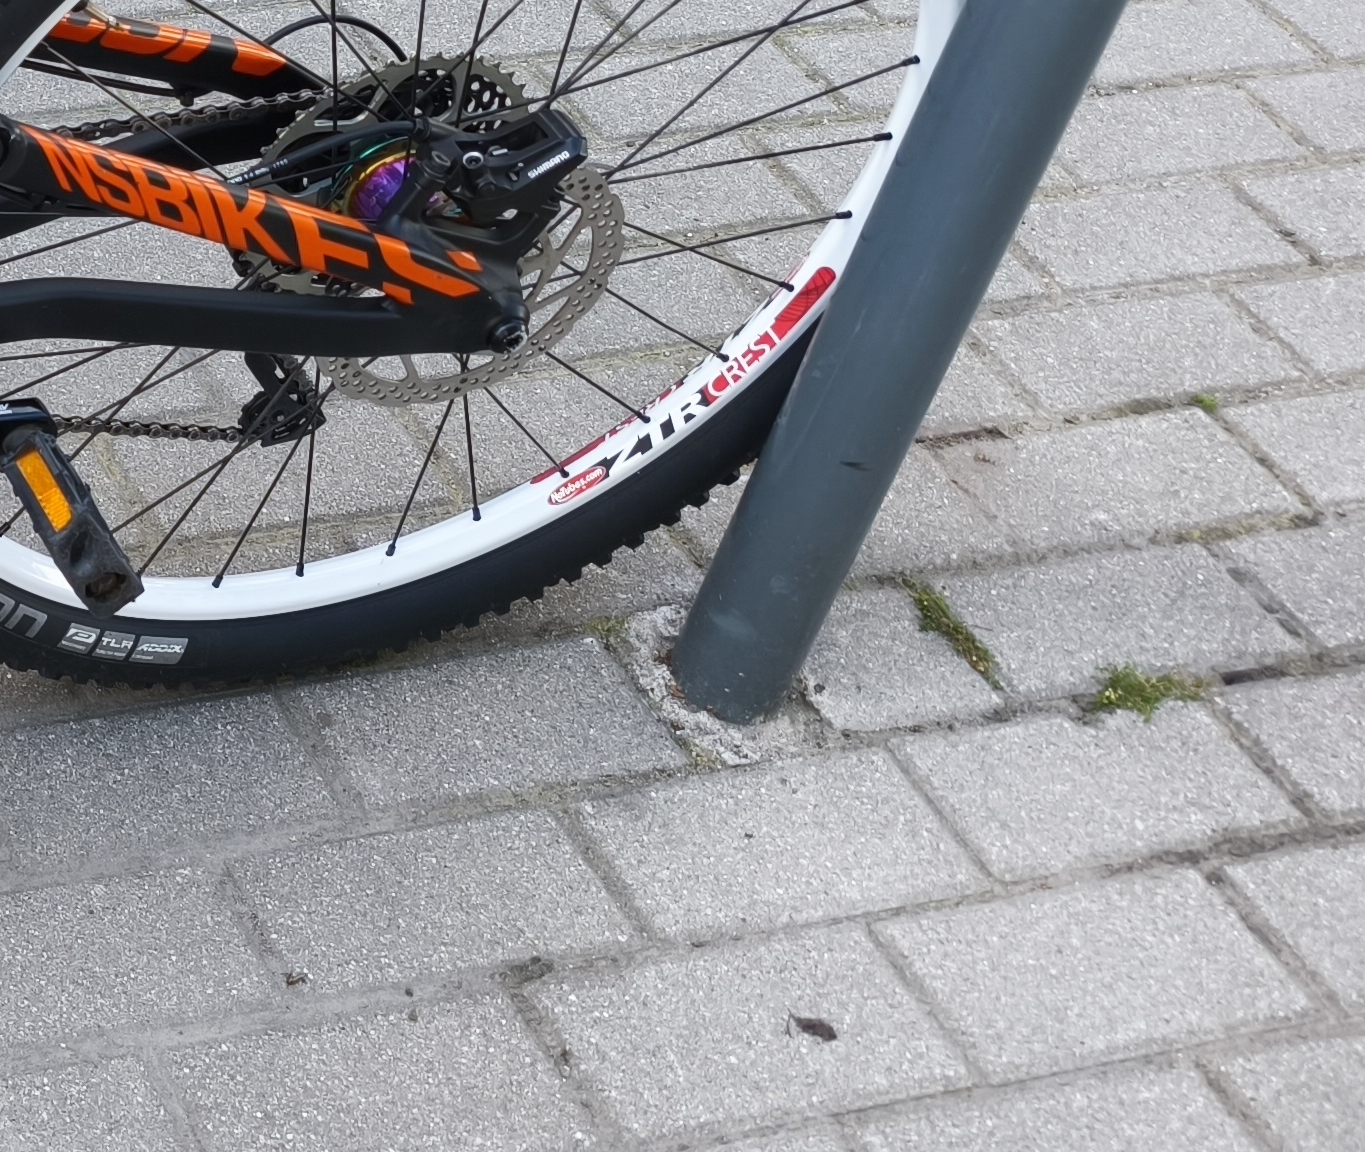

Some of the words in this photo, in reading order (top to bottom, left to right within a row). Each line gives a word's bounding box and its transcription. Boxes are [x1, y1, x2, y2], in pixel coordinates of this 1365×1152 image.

[528, 150, 570, 179] SHIMANO
[707, 329, 782, 398] CREST
[609, 392, 710, 478] ZTR
[550, 468, 603, 504] NoTubes.com
[101, 636, 134, 650] TLR
